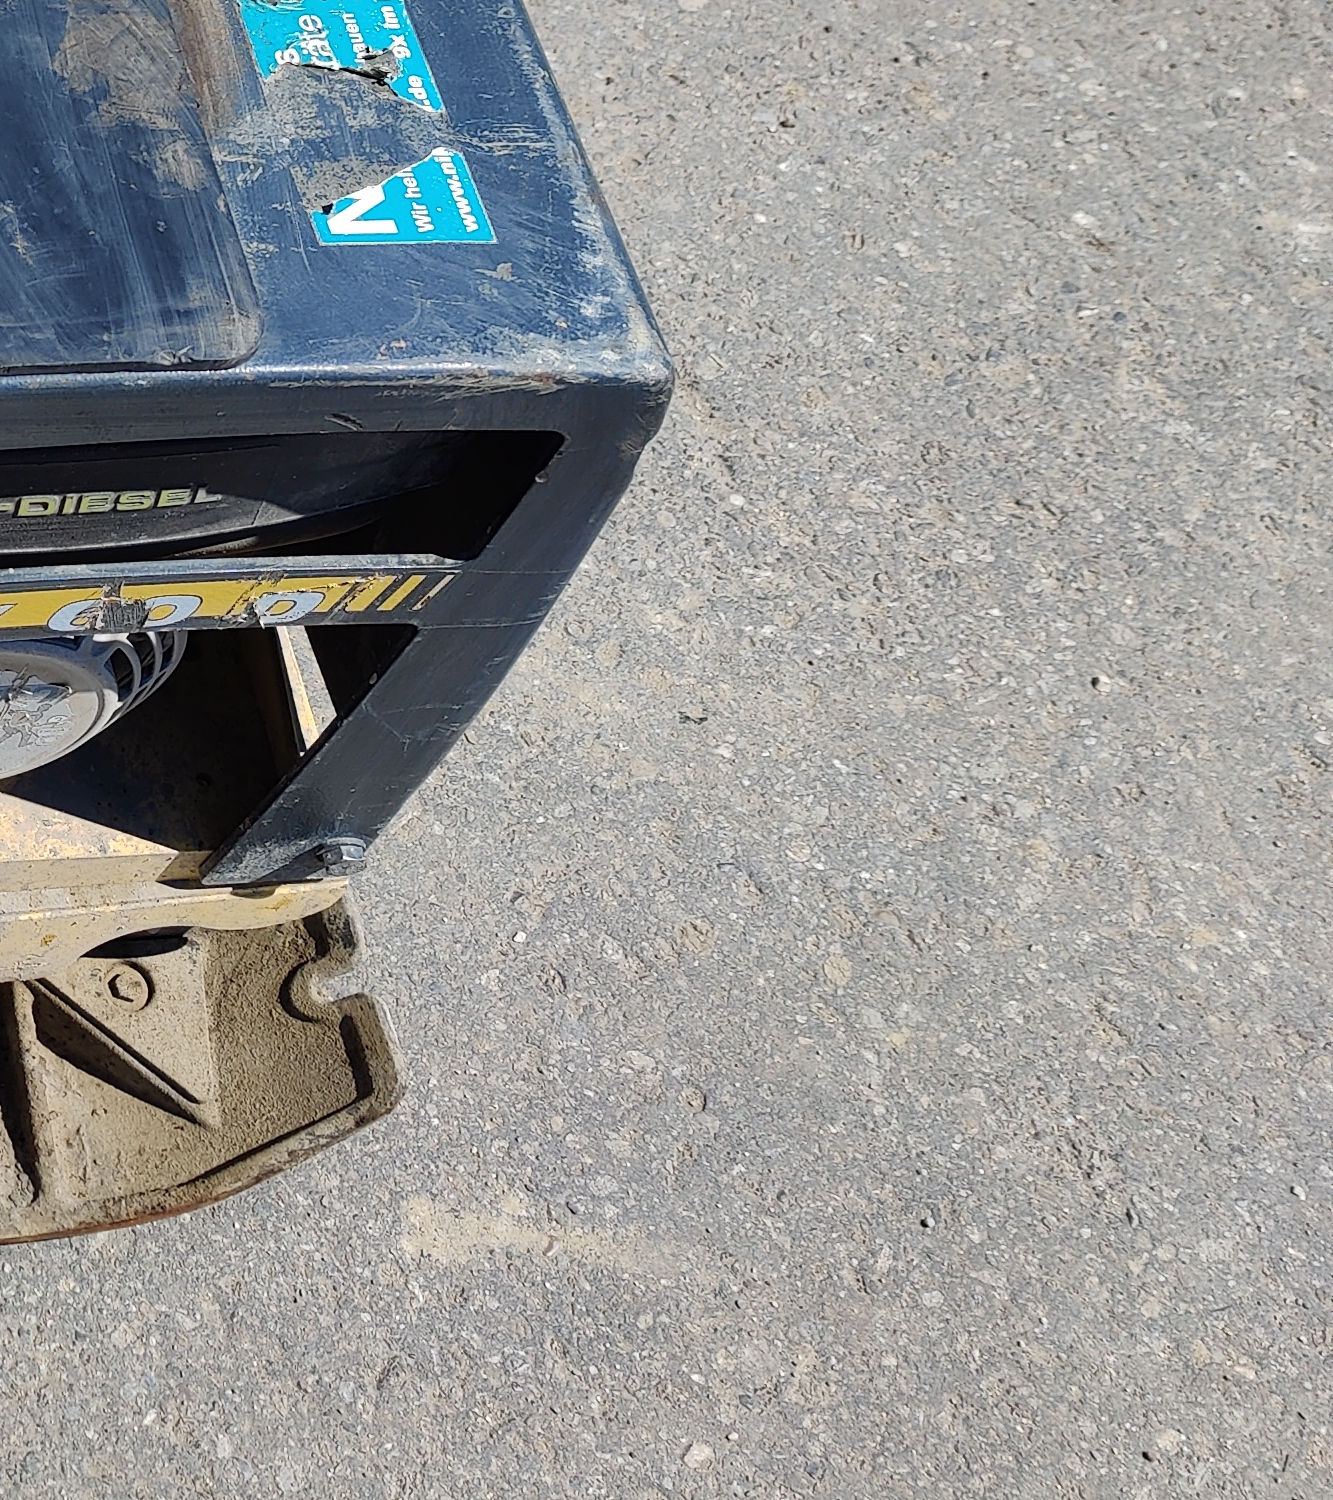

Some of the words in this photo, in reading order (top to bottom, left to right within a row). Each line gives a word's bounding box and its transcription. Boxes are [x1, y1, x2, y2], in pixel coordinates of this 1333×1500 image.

[380, 5, 401, 30] im
[388, 33, 412, 59] 9x
[411, 201, 435, 233] Wir
